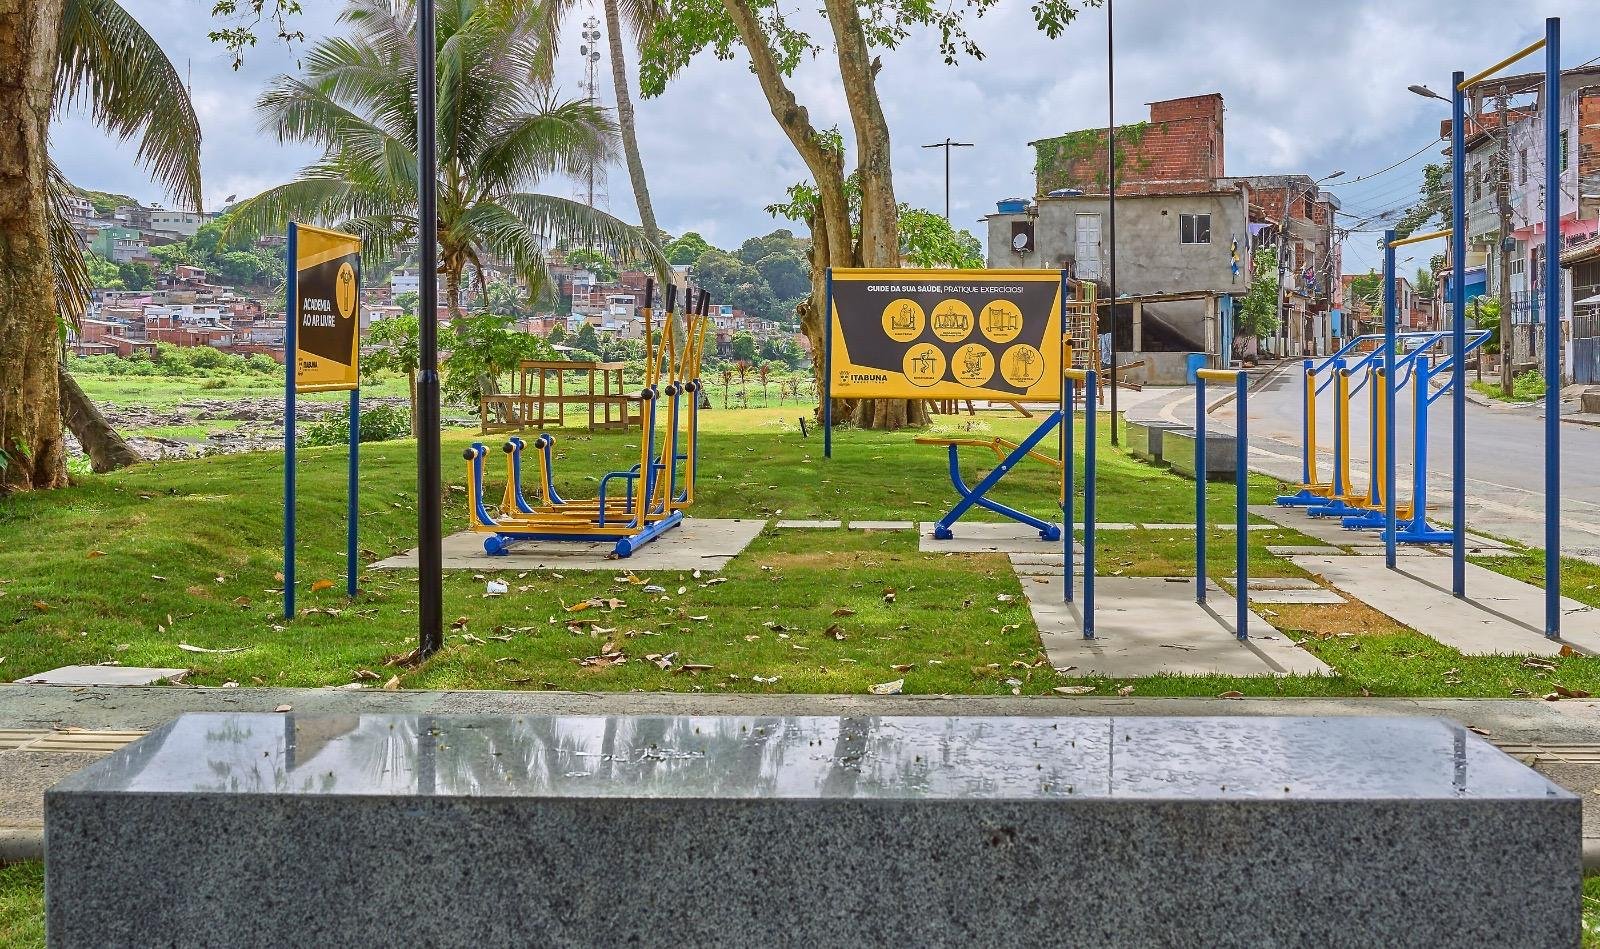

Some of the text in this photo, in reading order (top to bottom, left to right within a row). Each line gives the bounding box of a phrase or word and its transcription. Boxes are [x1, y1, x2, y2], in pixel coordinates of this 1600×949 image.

[901, 285, 917, 293] SUA
[943, 285, 979, 294] PRATIQUE
[303, 297, 331, 311] ACADEMIA
[302, 313, 336, 328] AO AR LIVRE
